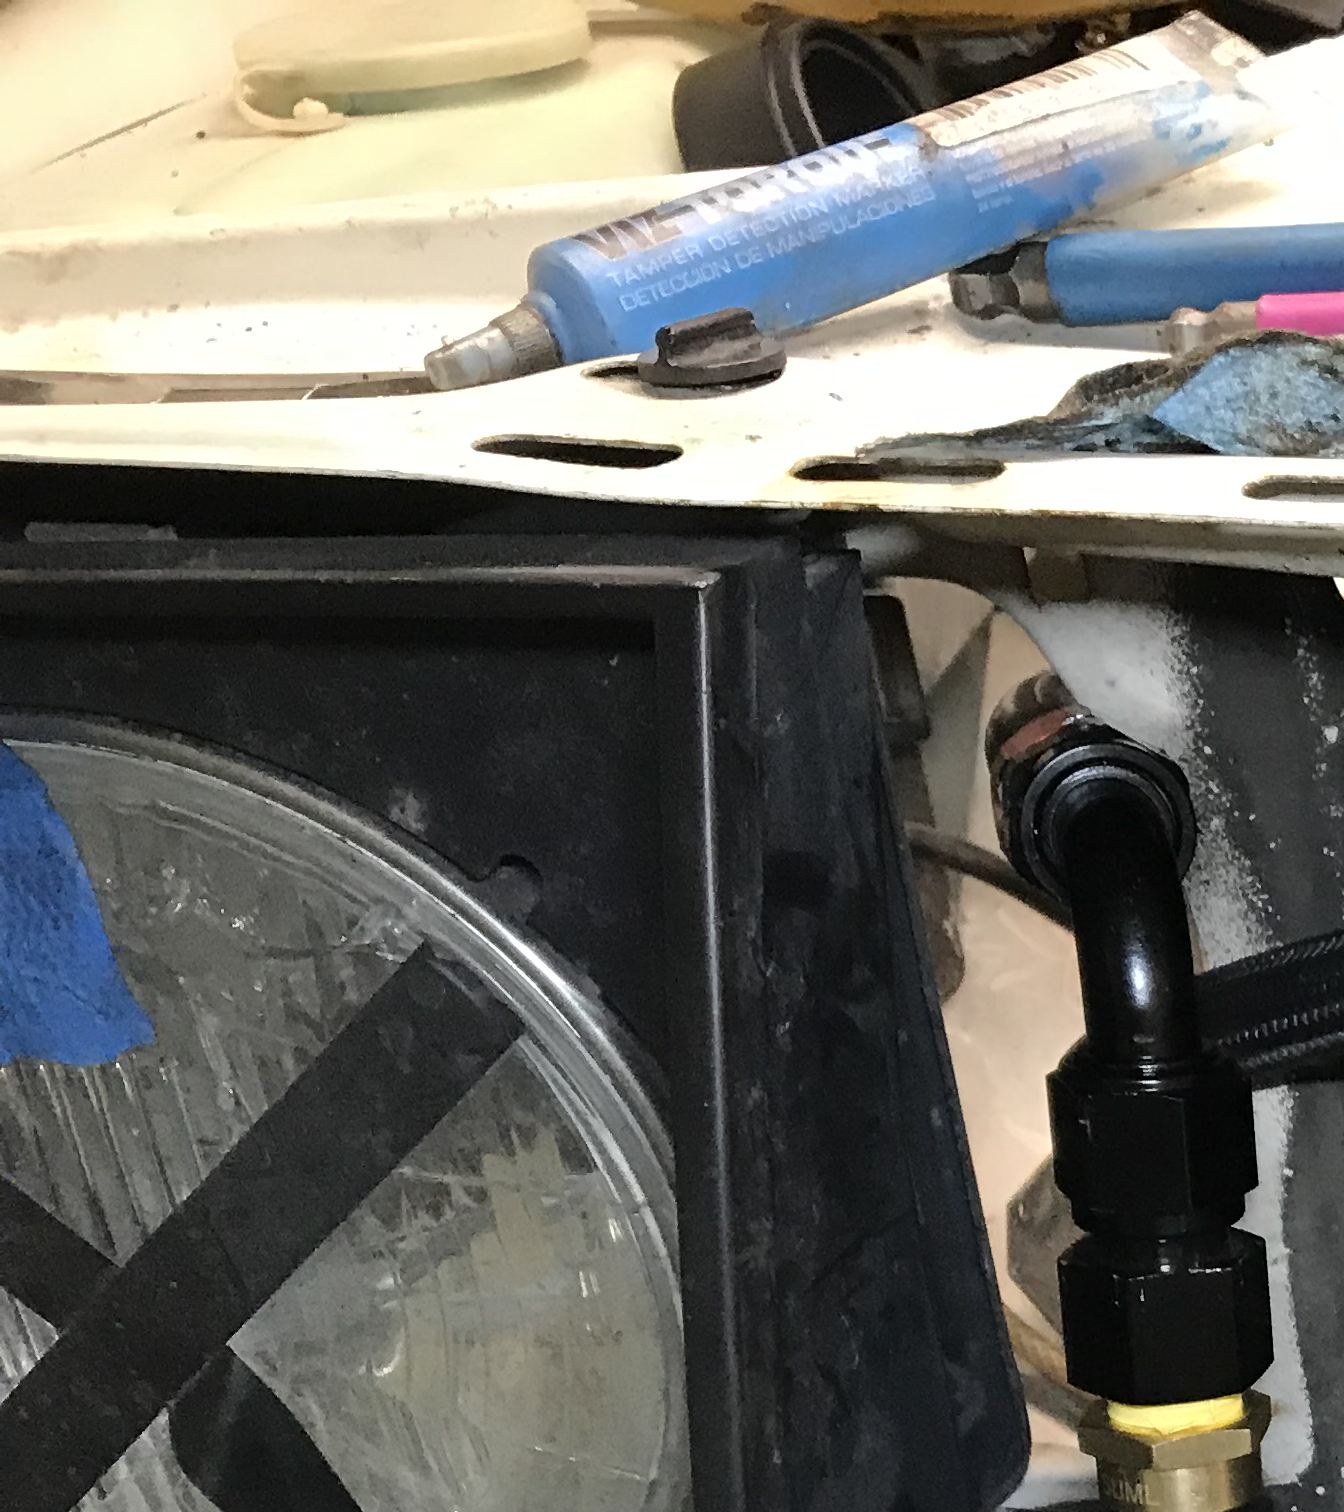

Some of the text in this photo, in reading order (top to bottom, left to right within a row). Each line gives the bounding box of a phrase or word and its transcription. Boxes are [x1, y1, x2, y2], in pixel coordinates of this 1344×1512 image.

[606, 244, 704, 289] TAMPER
[711, 197, 829, 252] DETECTION
[736, 246, 764, 270] DE
